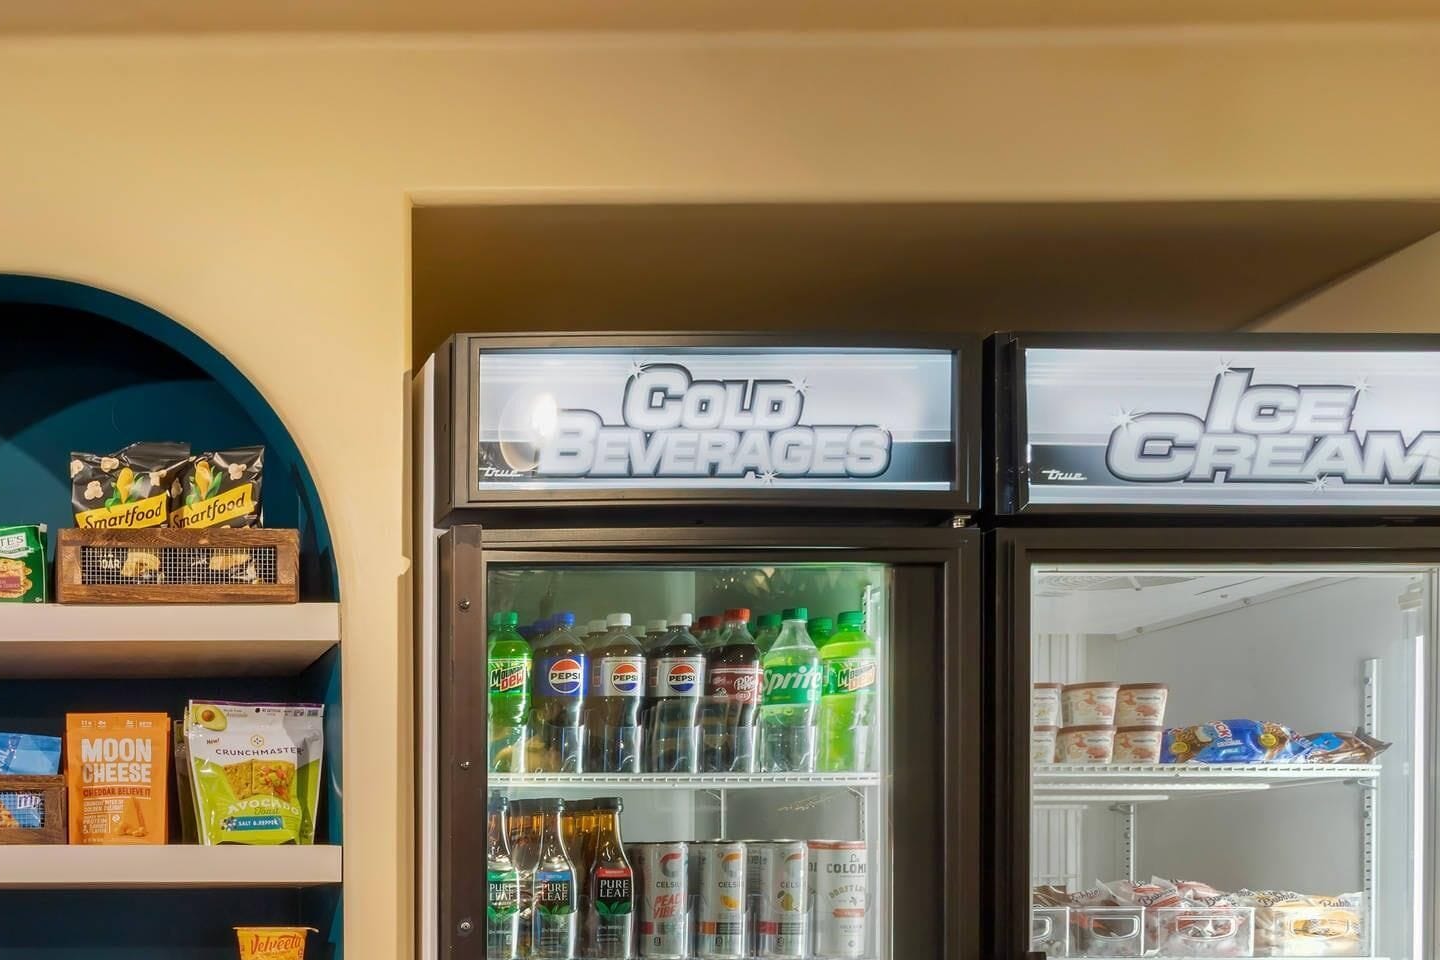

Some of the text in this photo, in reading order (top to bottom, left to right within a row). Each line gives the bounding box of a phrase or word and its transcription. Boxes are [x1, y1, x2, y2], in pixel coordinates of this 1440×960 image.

[623, 363, 803, 430] COLD
[1207, 367, 1362, 434] ICE
[538, 409, 893, 478] BEVERAGES
[1105, 411, 1440, 484] CREAM
[85, 501, 163, 529] Smartfood
[550, 672, 580, 680] PEPSI
[763, 665, 822, 695] Sprite
[81, 738, 152, 762] MOON
[215, 746, 304, 756] CRUNCHMASTER
[82, 763, 152, 783] CHEESE
[83, 787, 115, 797] CHEDDAR
[118, 787, 144, 796] BELIEVE
[227, 799, 300, 814] AVOCADO
[826, 862, 866, 874] COLOM
[489, 884, 514, 893] PURE
[541, 883, 568, 893] PURE
[599, 879, 629, 889] PURE
[541, 892, 569, 902] LEAF
[599, 888, 630, 898] LEAF
[250, 934, 302, 954] Velveeta
